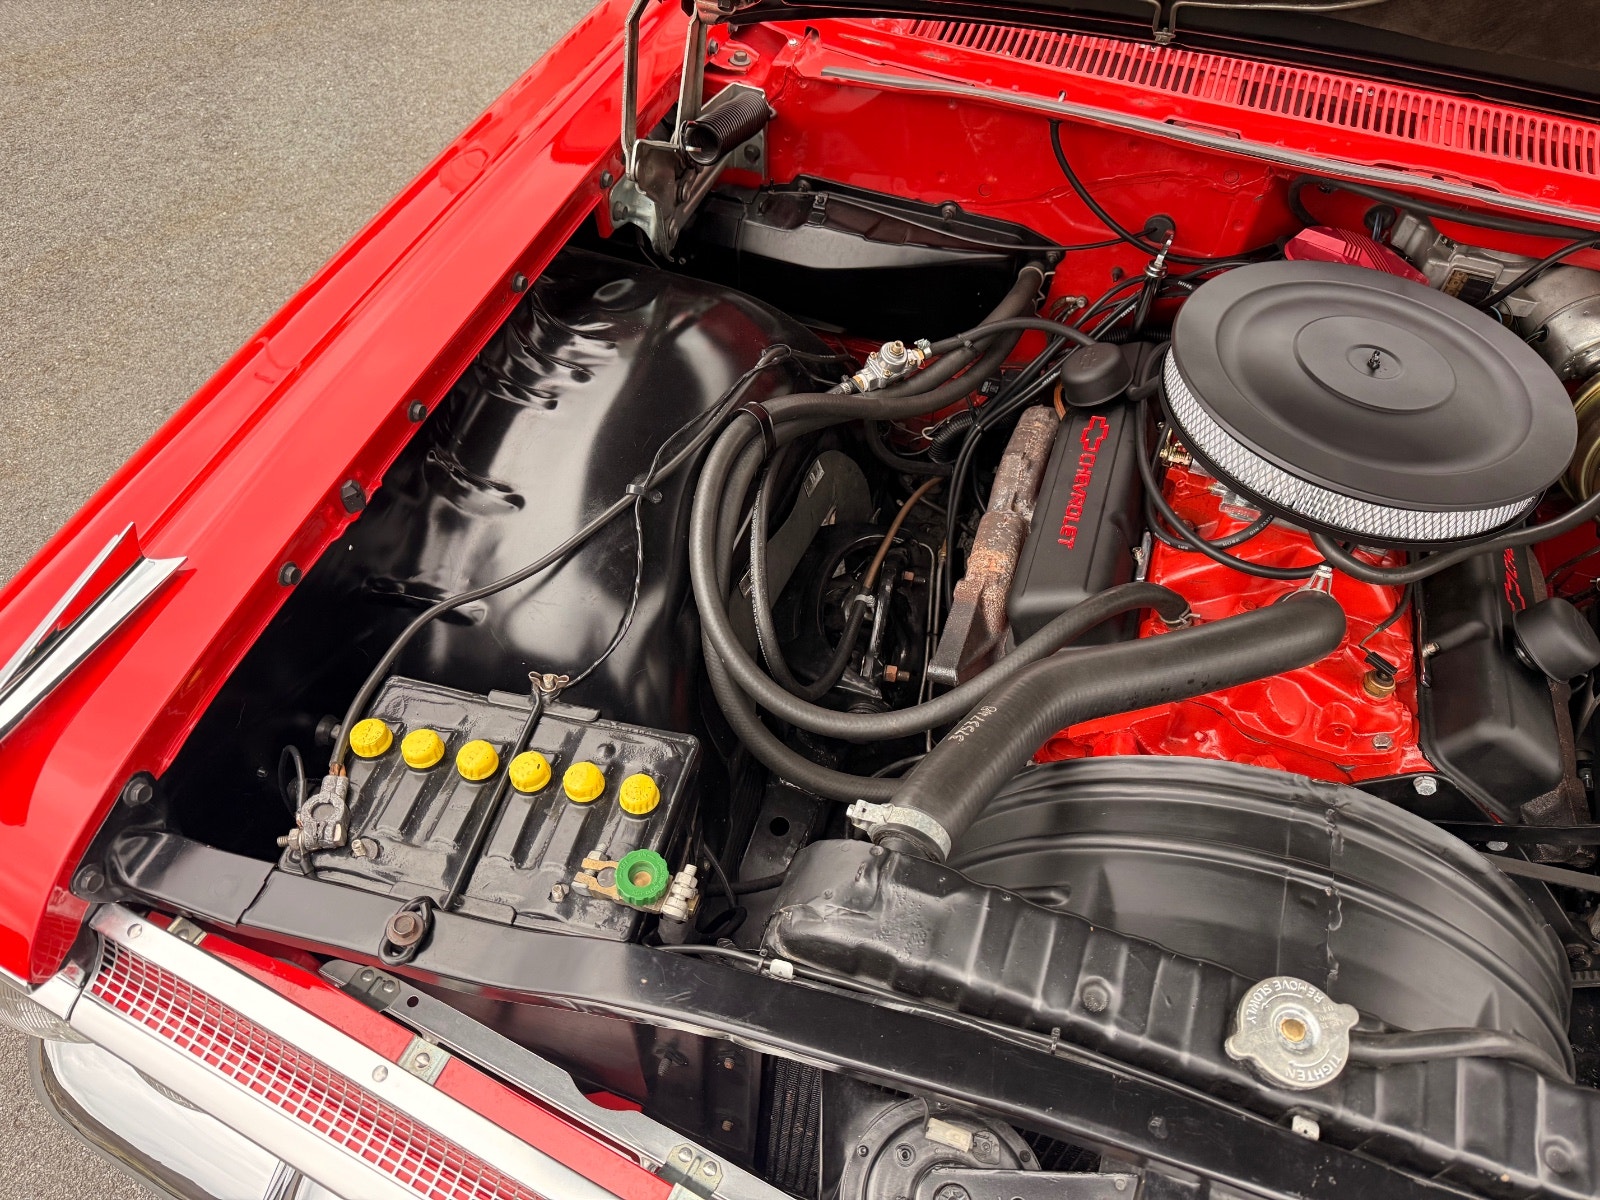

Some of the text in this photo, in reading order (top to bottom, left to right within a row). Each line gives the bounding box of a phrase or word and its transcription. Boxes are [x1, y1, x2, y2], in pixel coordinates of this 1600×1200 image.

[1058, 453, 1096, 549] CHEVROLET
[1246, 980, 1325, 1024] REMOVE SLOWLY
[1285, 1054, 1342, 1082] TIGHTEN
